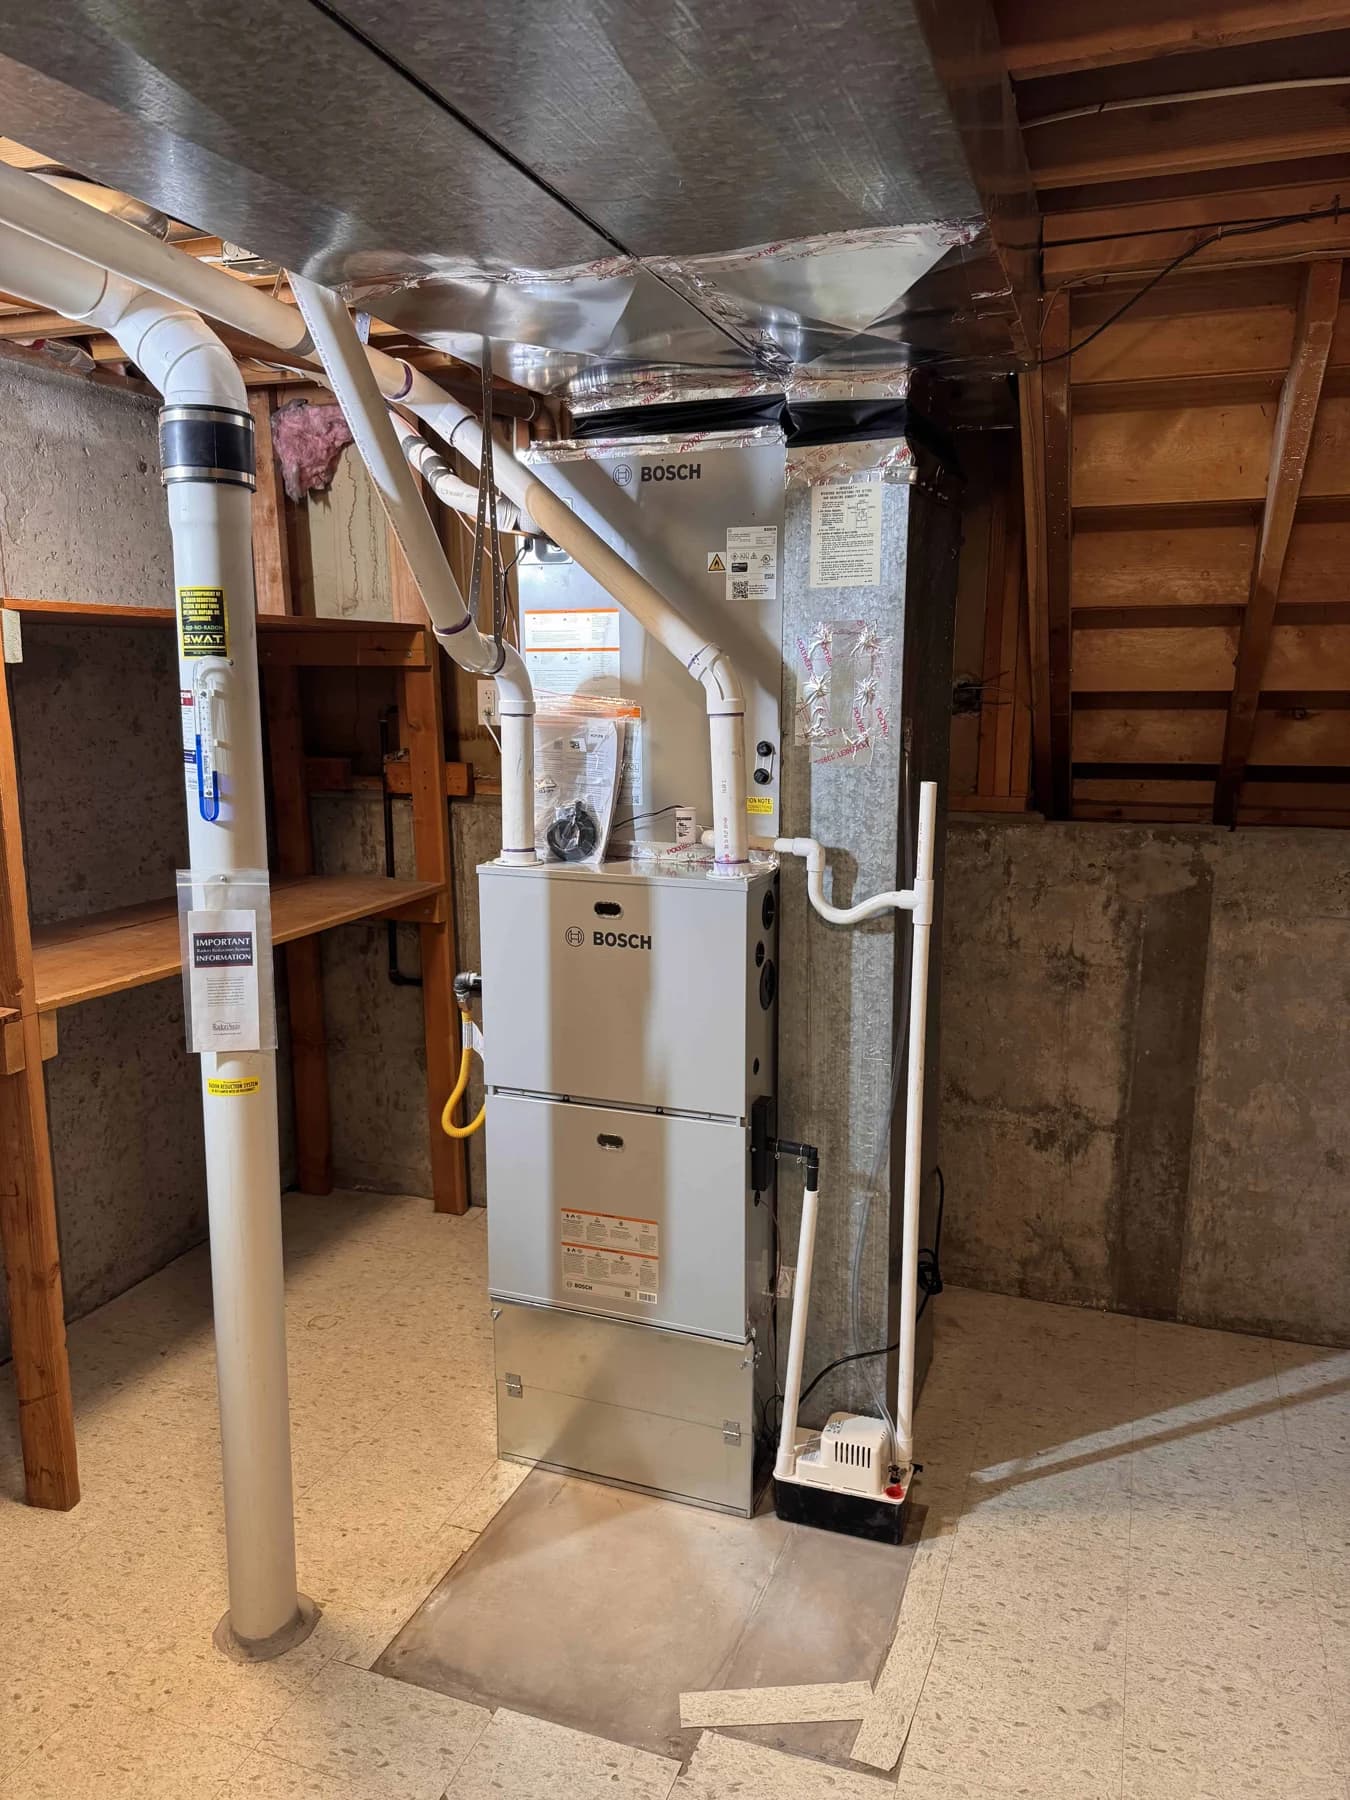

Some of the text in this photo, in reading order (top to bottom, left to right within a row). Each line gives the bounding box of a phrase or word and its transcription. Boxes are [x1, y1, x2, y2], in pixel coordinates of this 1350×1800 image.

[641, 463, 702, 482] BOSCH
[196, 937, 251, 947] IMPORTANT
[593, 931, 652, 950] BOSCH
[196, 952, 252, 963] INFORMATION
[574, 1282, 593, 1292] BOSCH
